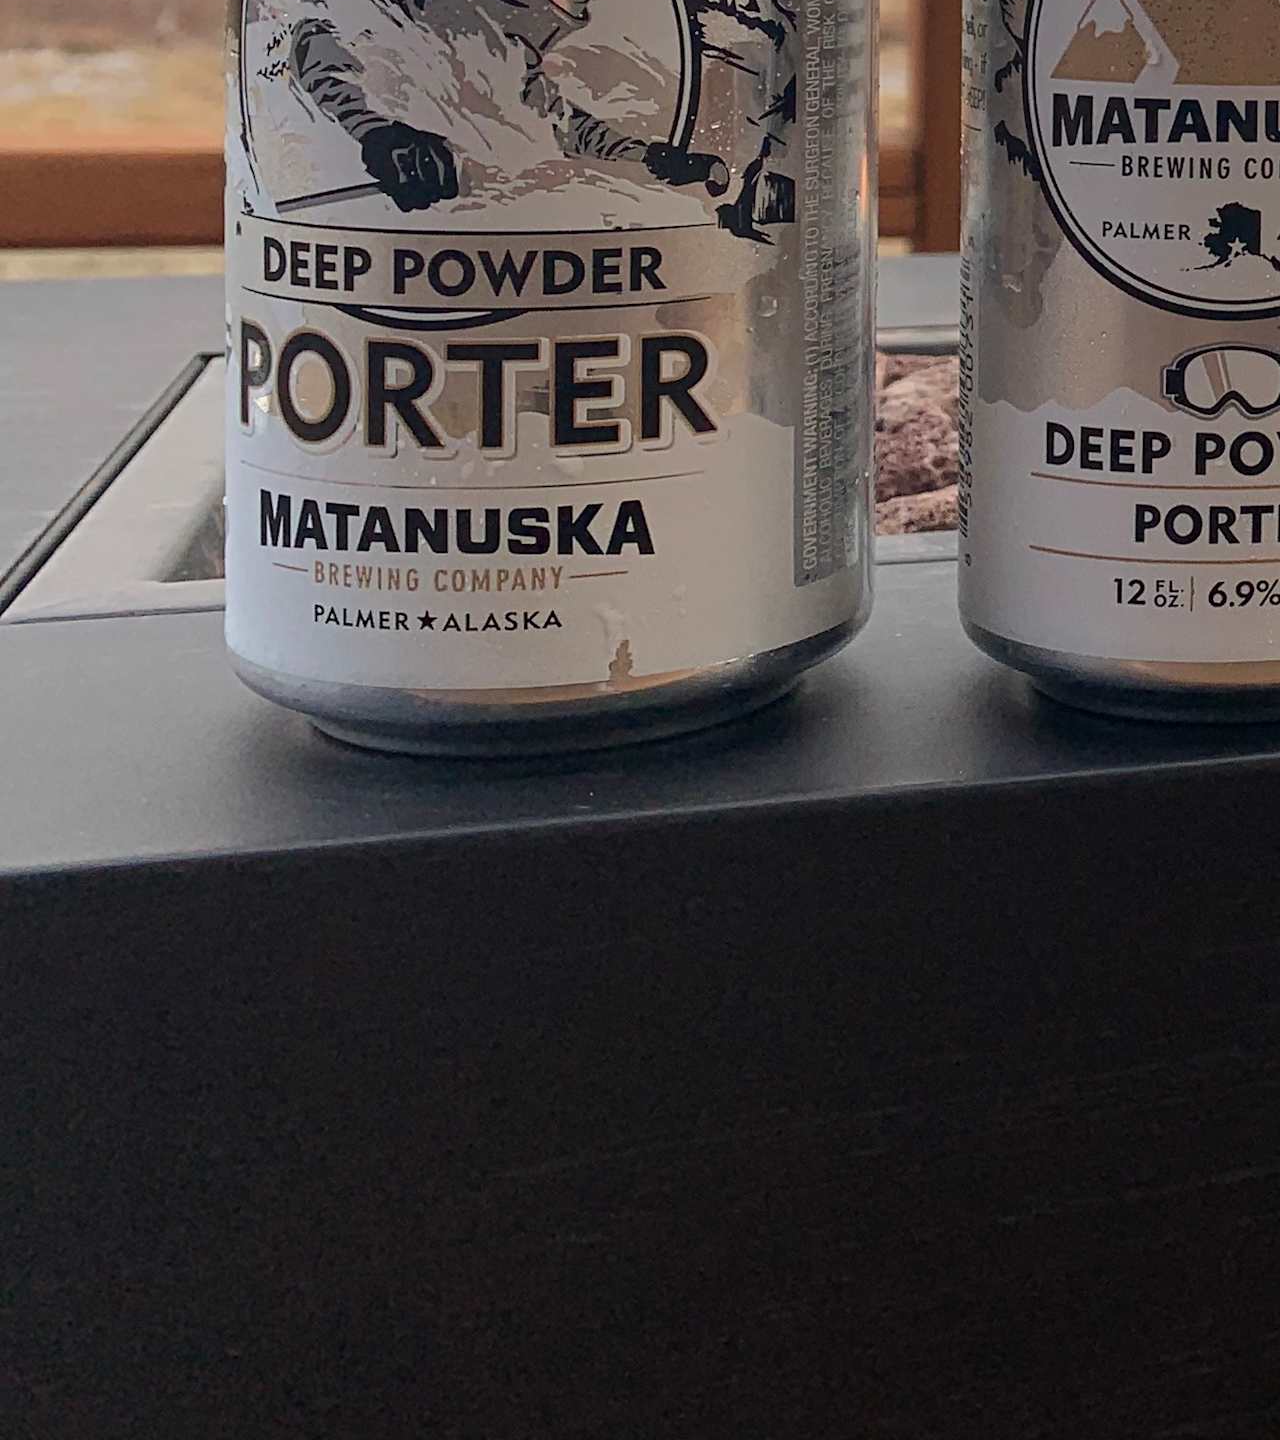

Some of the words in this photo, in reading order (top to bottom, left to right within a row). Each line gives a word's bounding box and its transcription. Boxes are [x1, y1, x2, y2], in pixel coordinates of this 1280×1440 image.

[823, 15, 836, 48] RISK
[822, 55, 835, 91] THE
[822, 98, 834, 119] OF
[805, 115, 820, 190] SURGEON
[1121, 154, 1232, 179] BREWING
[805, 192, 820, 221] THE
[804, 227, 820, 248] TO
[1102, 221, 1192, 241] PALMER
[263, 235, 373, 294] DEEP
[394, 246, 667, 298] POWDER
[804, 249, 820, 342] ACCORDING
[239, 317, 724, 456] PORTER
[803, 368, 819, 454] WARNING:
[1045, 421, 1172, 474] DEEP
[259, 489, 656, 556] MATANUSKA
[803, 457, 819, 570] GOVERNMENT
[819, 478, 833, 562] ALCOHOLIC
[313, 561, 420, 592] BREWING
[434, 566, 564, 592] COMPANY
[1113, 578, 1147, 605] 12
[1155, 579, 1184, 593] FL.
[1153, 594, 1184, 608] OZ.
[314, 604, 411, 631] PALMER
[442, 609, 563, 632] ALASKA
